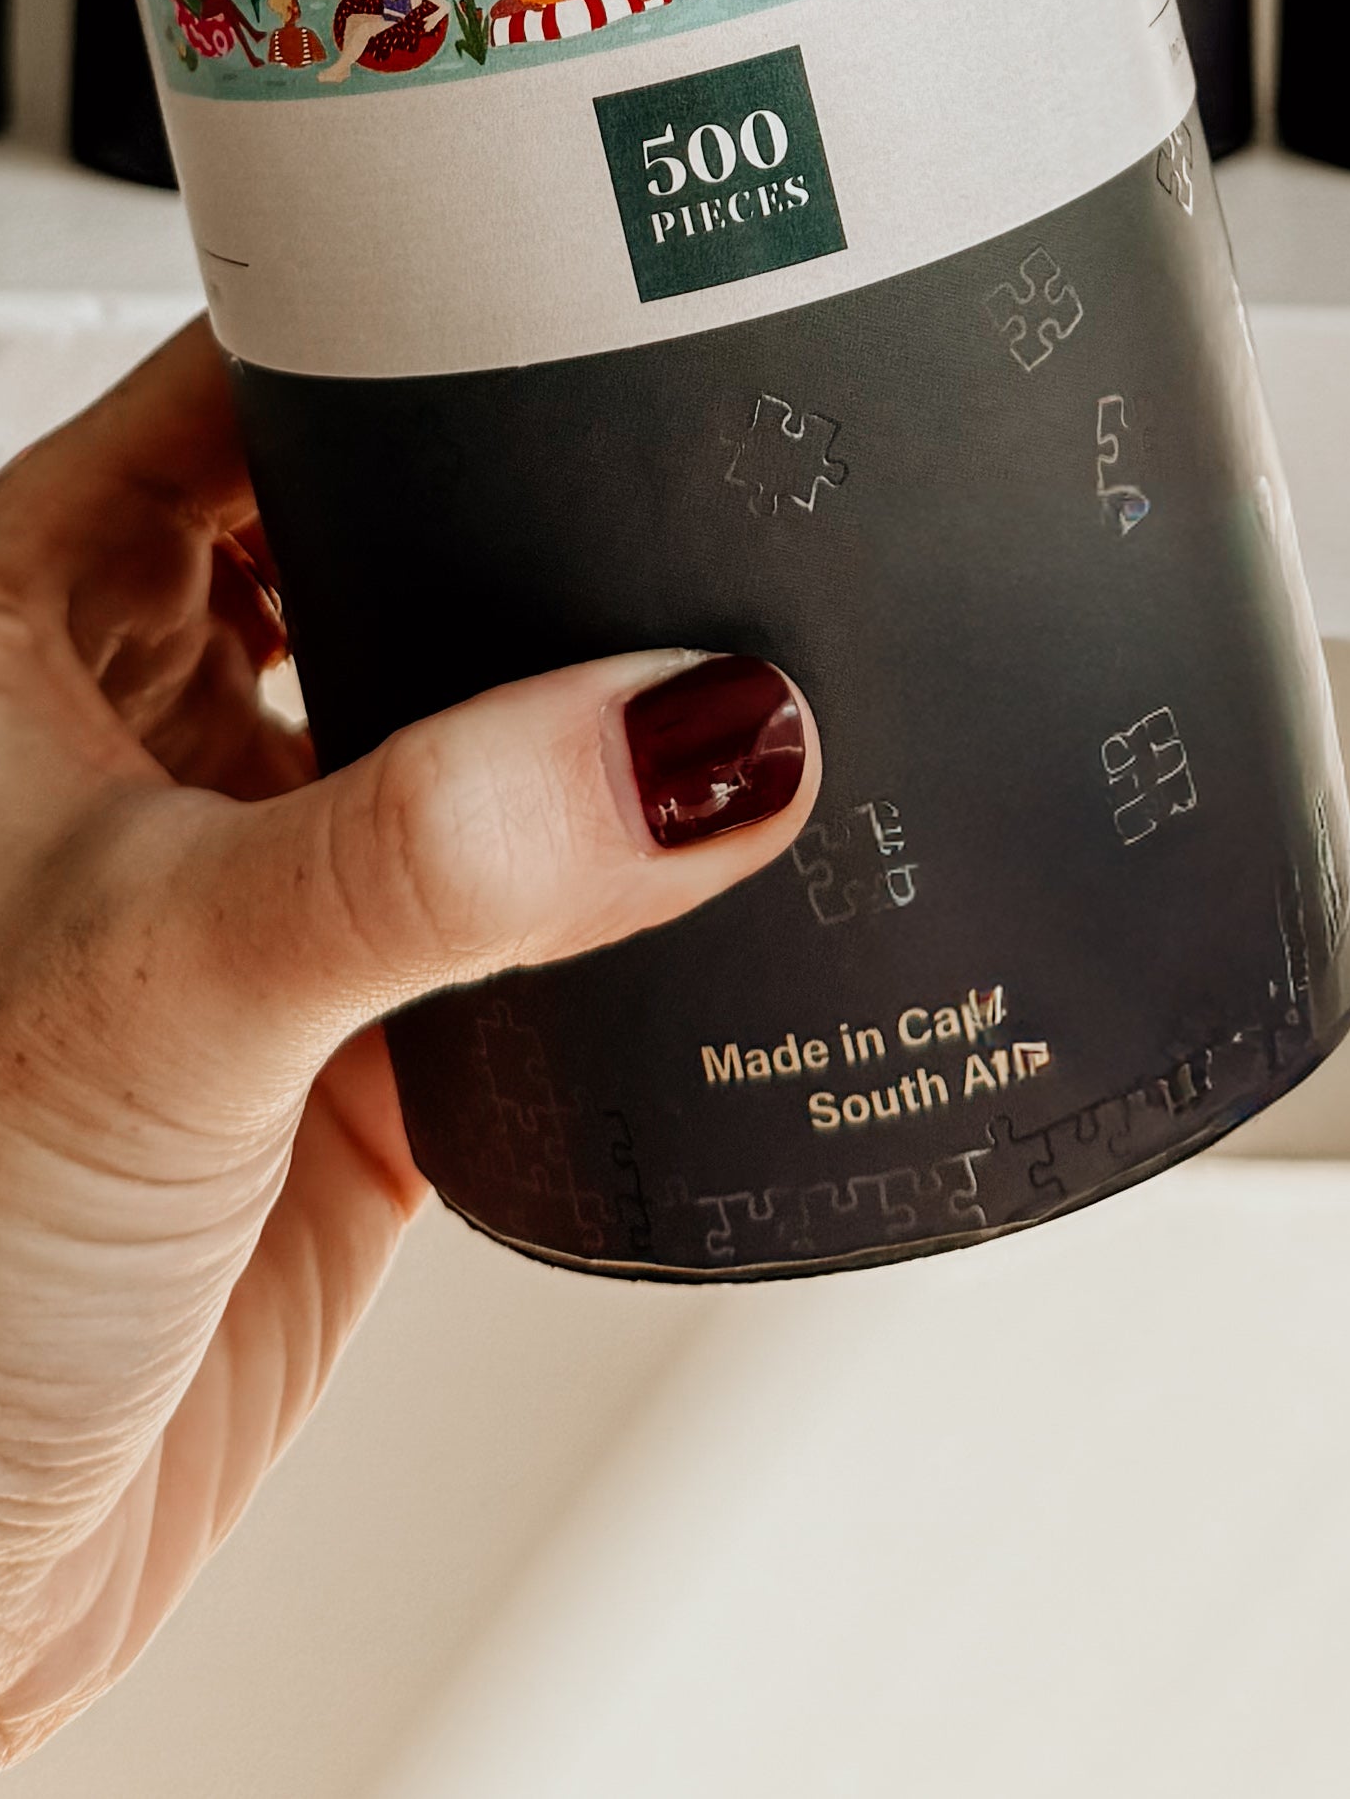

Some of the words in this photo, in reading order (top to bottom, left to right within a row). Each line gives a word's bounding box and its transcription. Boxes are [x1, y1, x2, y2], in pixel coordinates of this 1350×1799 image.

[641, 109, 789, 196] 500
[650, 174, 810, 244] PIECES
[701, 1032, 830, 1084] Made
[839, 1023, 887, 1064] in
[808, 1067, 949, 1130] South
